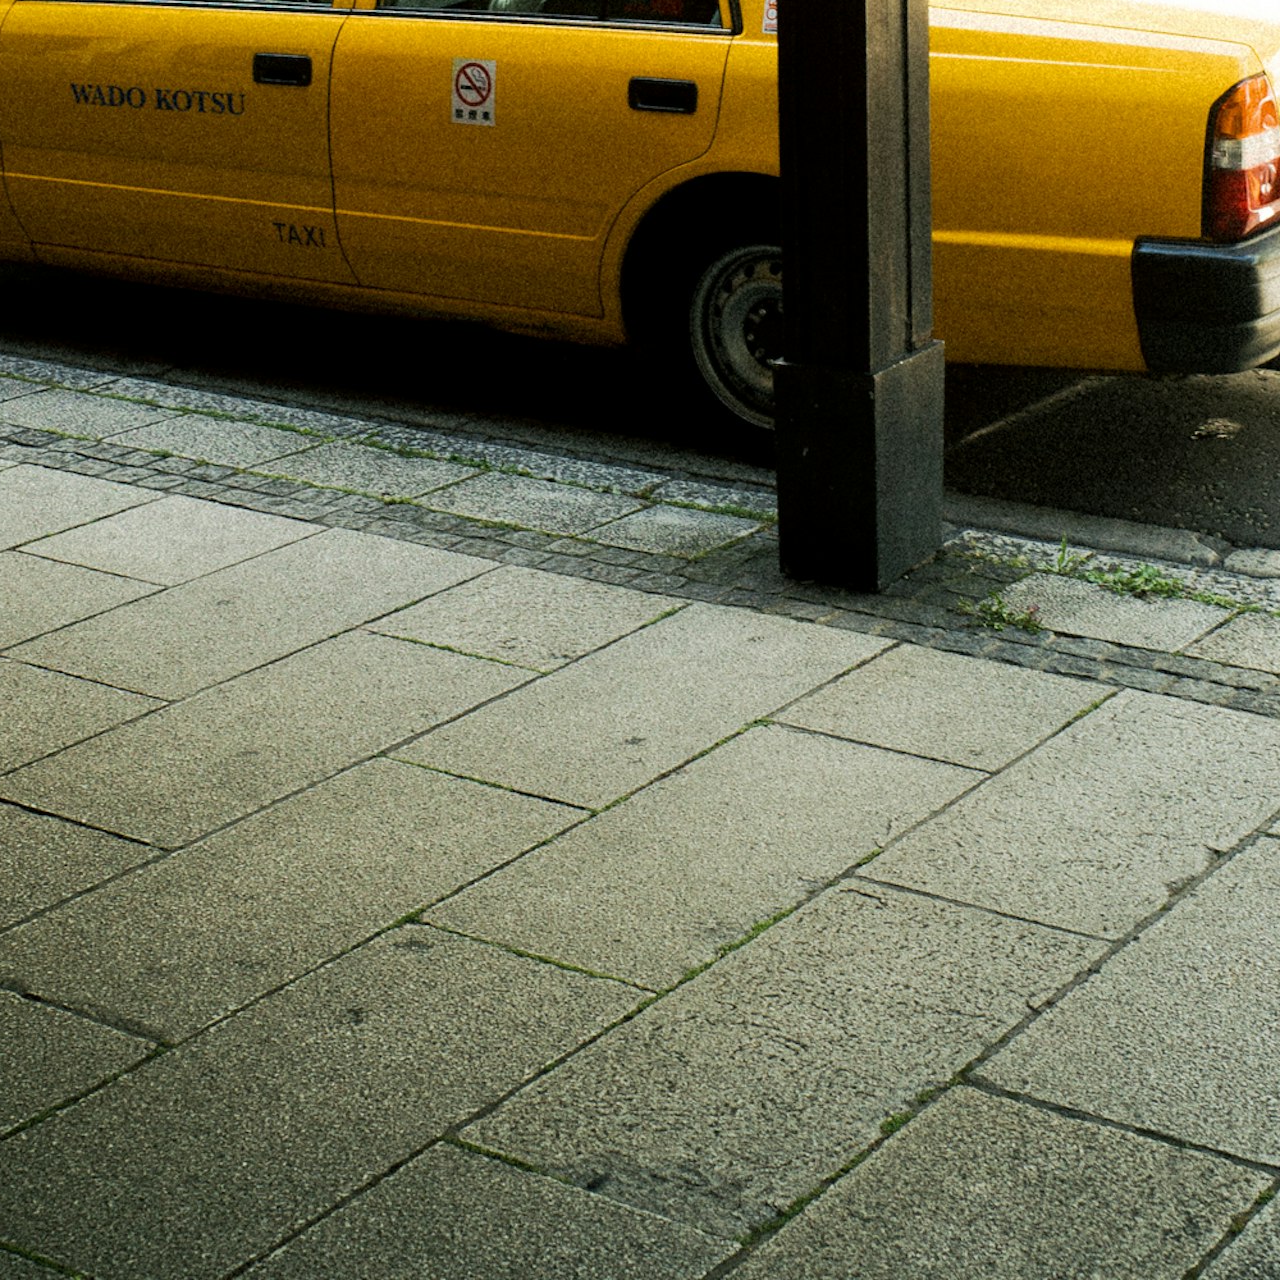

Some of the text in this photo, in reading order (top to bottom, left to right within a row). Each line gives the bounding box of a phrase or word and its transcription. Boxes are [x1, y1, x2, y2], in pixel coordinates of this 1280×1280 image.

[70, 82, 246, 116] WADO KOTSU
[272, 221, 326, 248] TAXI
